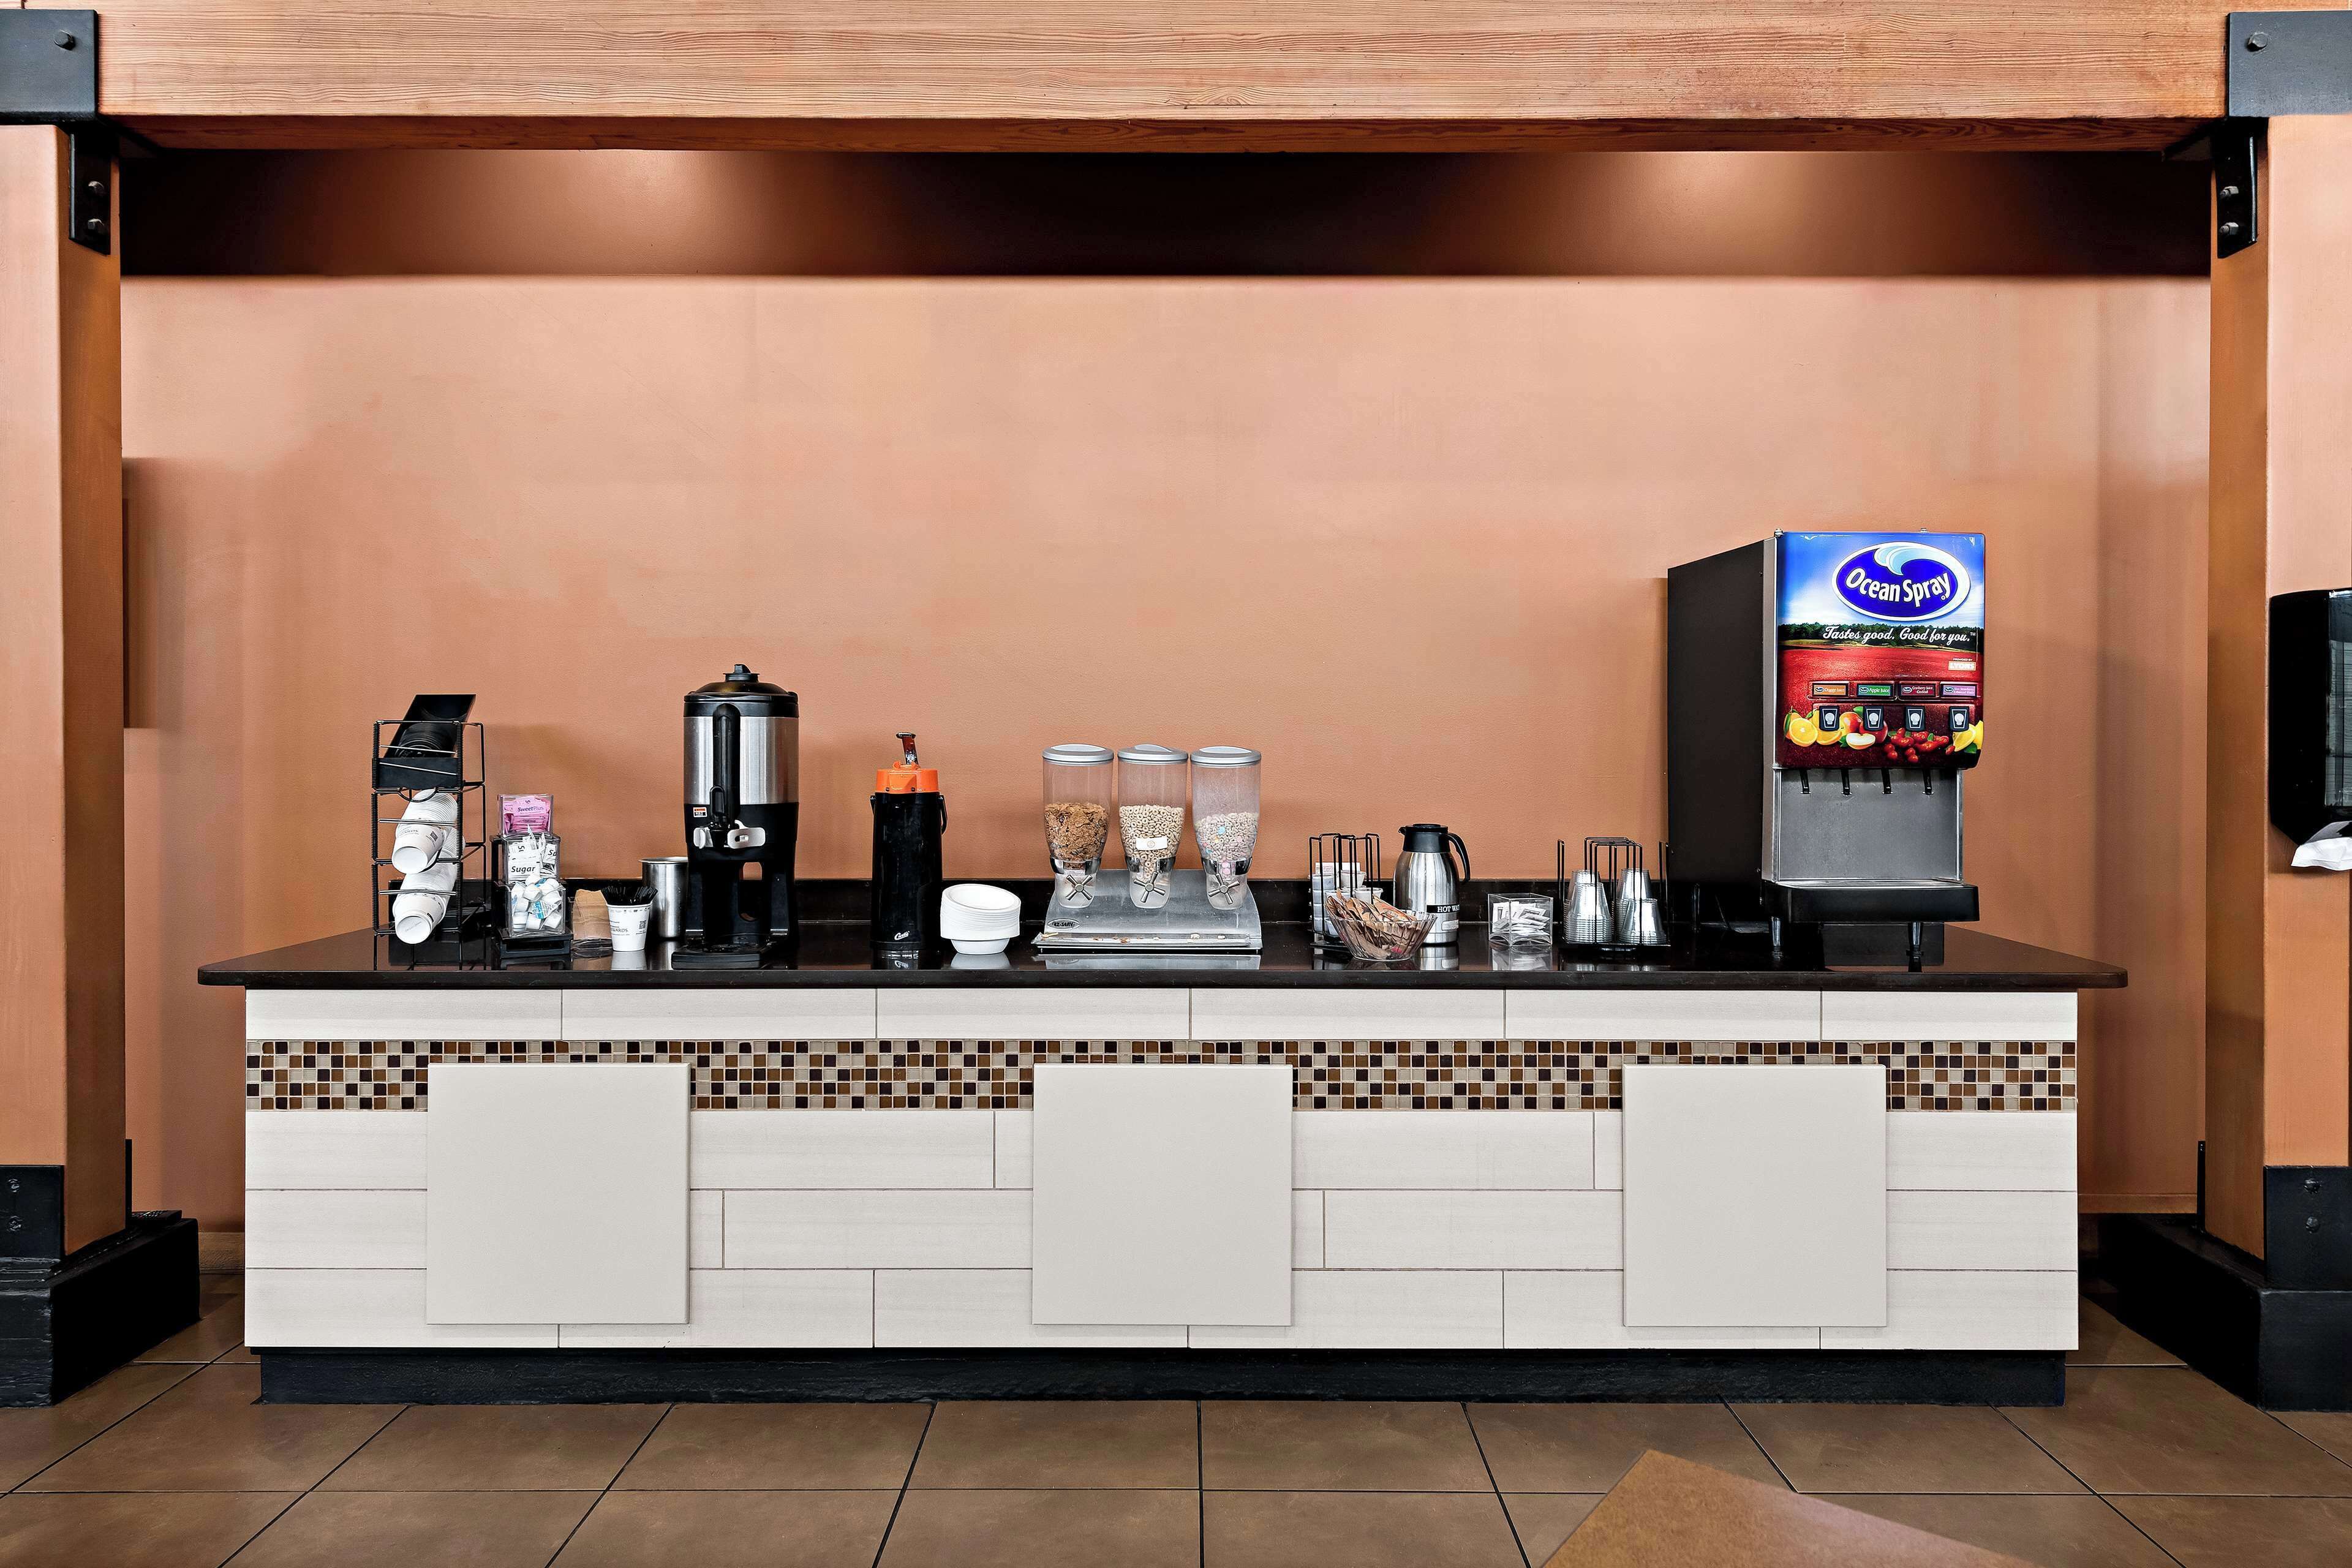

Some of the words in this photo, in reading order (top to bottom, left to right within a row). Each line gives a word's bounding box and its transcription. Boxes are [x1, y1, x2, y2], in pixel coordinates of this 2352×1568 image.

[1845, 568, 1901, 602] Ocean
[1902, 572, 1951, 608] Spray
[1822, 625, 1861, 639] Tastes
[1861, 628, 1895, 644] good.
[1899, 627, 1929, 641] Good
[1928, 628, 1947, 643] for
[511, 865, 536, 874] Sugar
